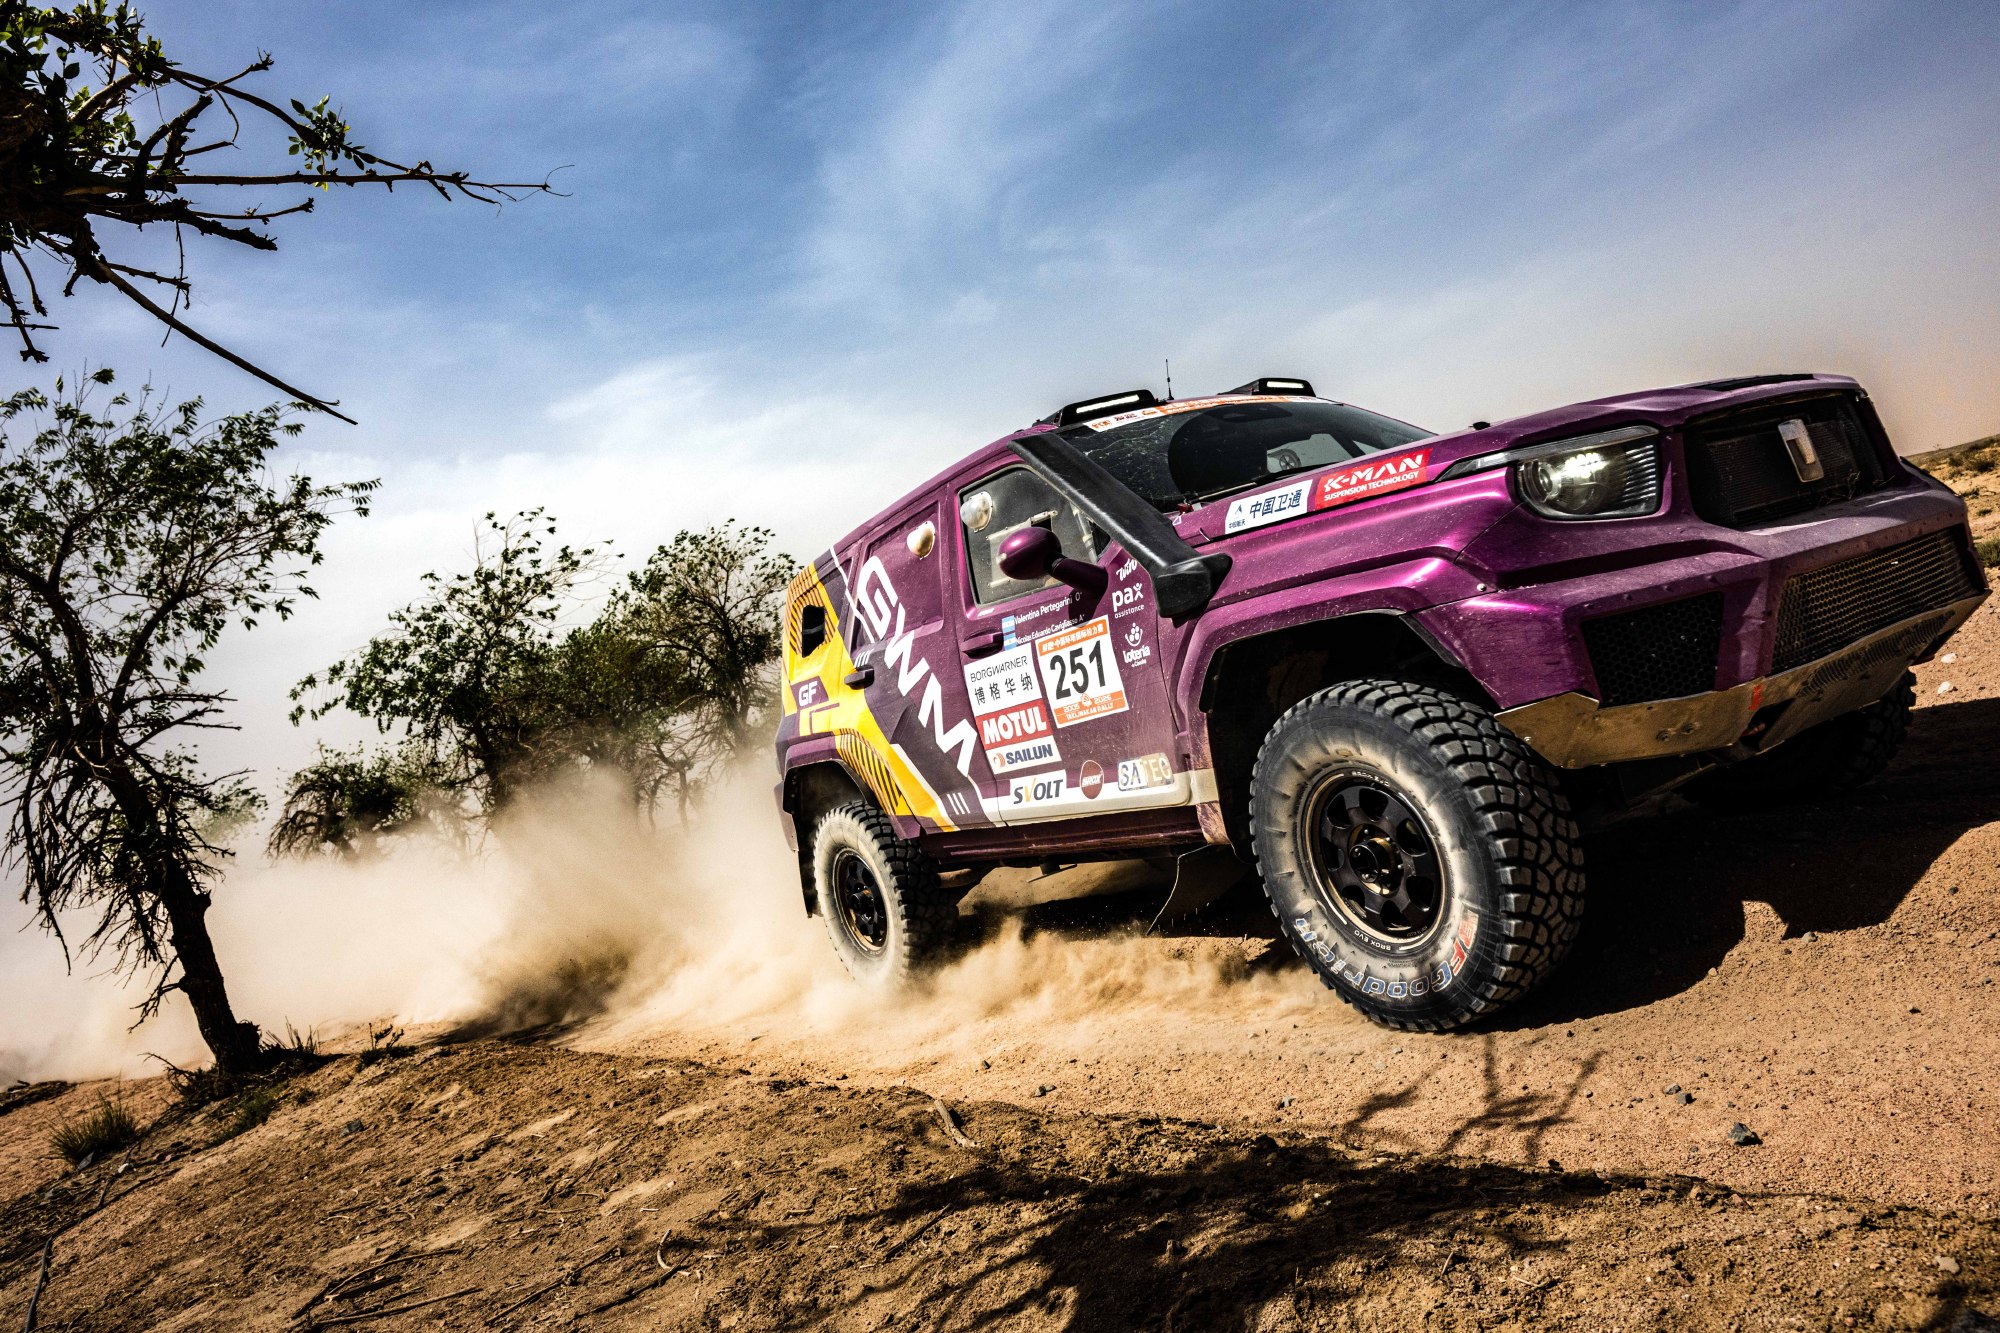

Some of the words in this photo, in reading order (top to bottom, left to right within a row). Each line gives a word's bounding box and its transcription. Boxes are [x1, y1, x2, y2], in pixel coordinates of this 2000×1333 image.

[1323, 454, 1423, 493] K-MAN
[1323, 485, 1367, 502] SUSPENSION
[1367, 470, 1420, 490] TECHNOLOGY
[1249, 489, 1302, 519] 中国卫通
[1014, 609, 1040, 625] Valentina
[1032, 626, 1052, 640] Eduardo
[857, 555, 977, 778] GWM
[970, 655, 1028, 682] BORGWARNER
[1049, 640, 1105, 700] 251
[798, 680, 818, 706] GF
[974, 672, 1034, 705] 博格华纳
[982, 706, 1047, 745] MOTUL
[1005, 744, 1053, 765] SAILUN
[1013, 777, 1064, 804] SVOLT
[1354, 929, 1369, 943] EVO
